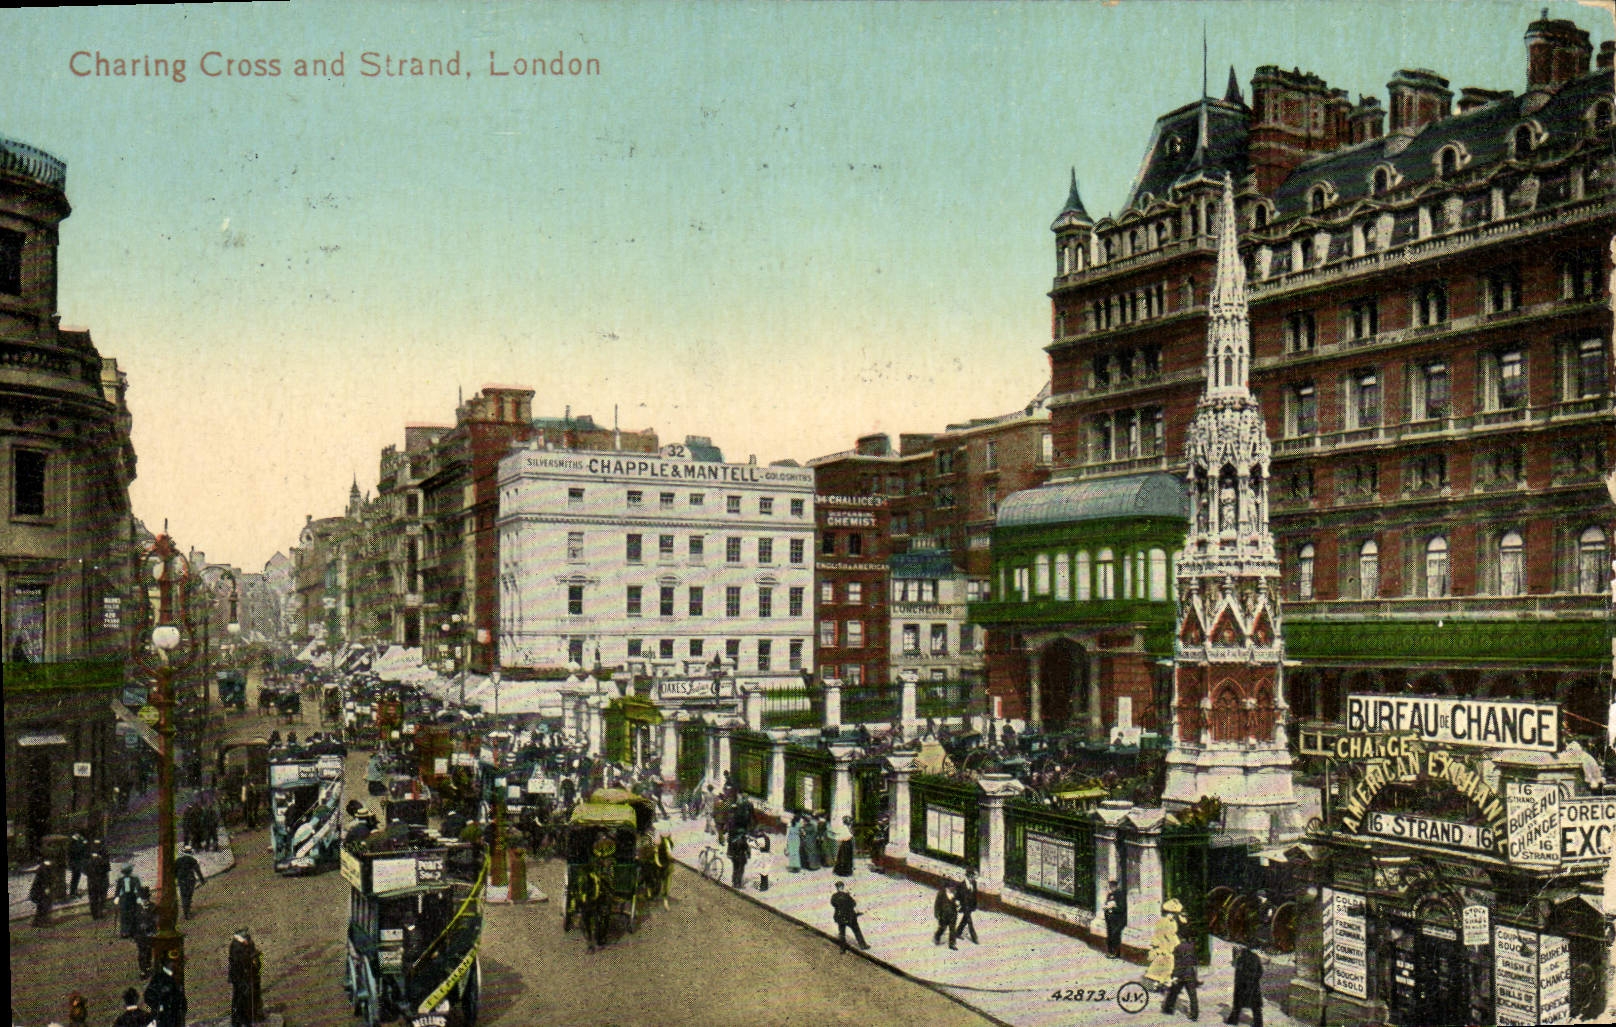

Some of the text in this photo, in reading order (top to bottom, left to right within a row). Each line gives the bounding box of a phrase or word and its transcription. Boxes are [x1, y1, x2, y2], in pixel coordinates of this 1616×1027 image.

[667, 444, 685, 458] 32
[527, 457, 583, 470] SILVERSMITHS
[588, 459, 669, 476] CHAPPLE
[683, 466, 759, 482] MANTELL
[764, 472, 812, 483] GOLDSMITHS
[829, 494, 873, 506] CHALLICE
[827, 516, 877, 528] CHEMIST
[893, 604, 953, 615] LUNCHEONS
[1349, 698, 1555, 747] BUREAU DE CHANGE
[1343, 752, 1420, 834] AMERICAN
[1519, 784, 1533, 796] 16
[1510, 790, 1556, 834] BUREAU
[1368, 813, 1493, 849] 16 STRAND 16
[1511, 813, 1558, 857] CHANGE
[1561, 824, 1615, 857] EXC
[1539, 840, 1553, 851] 16
[1522, 851, 1559, 861] STRAND
